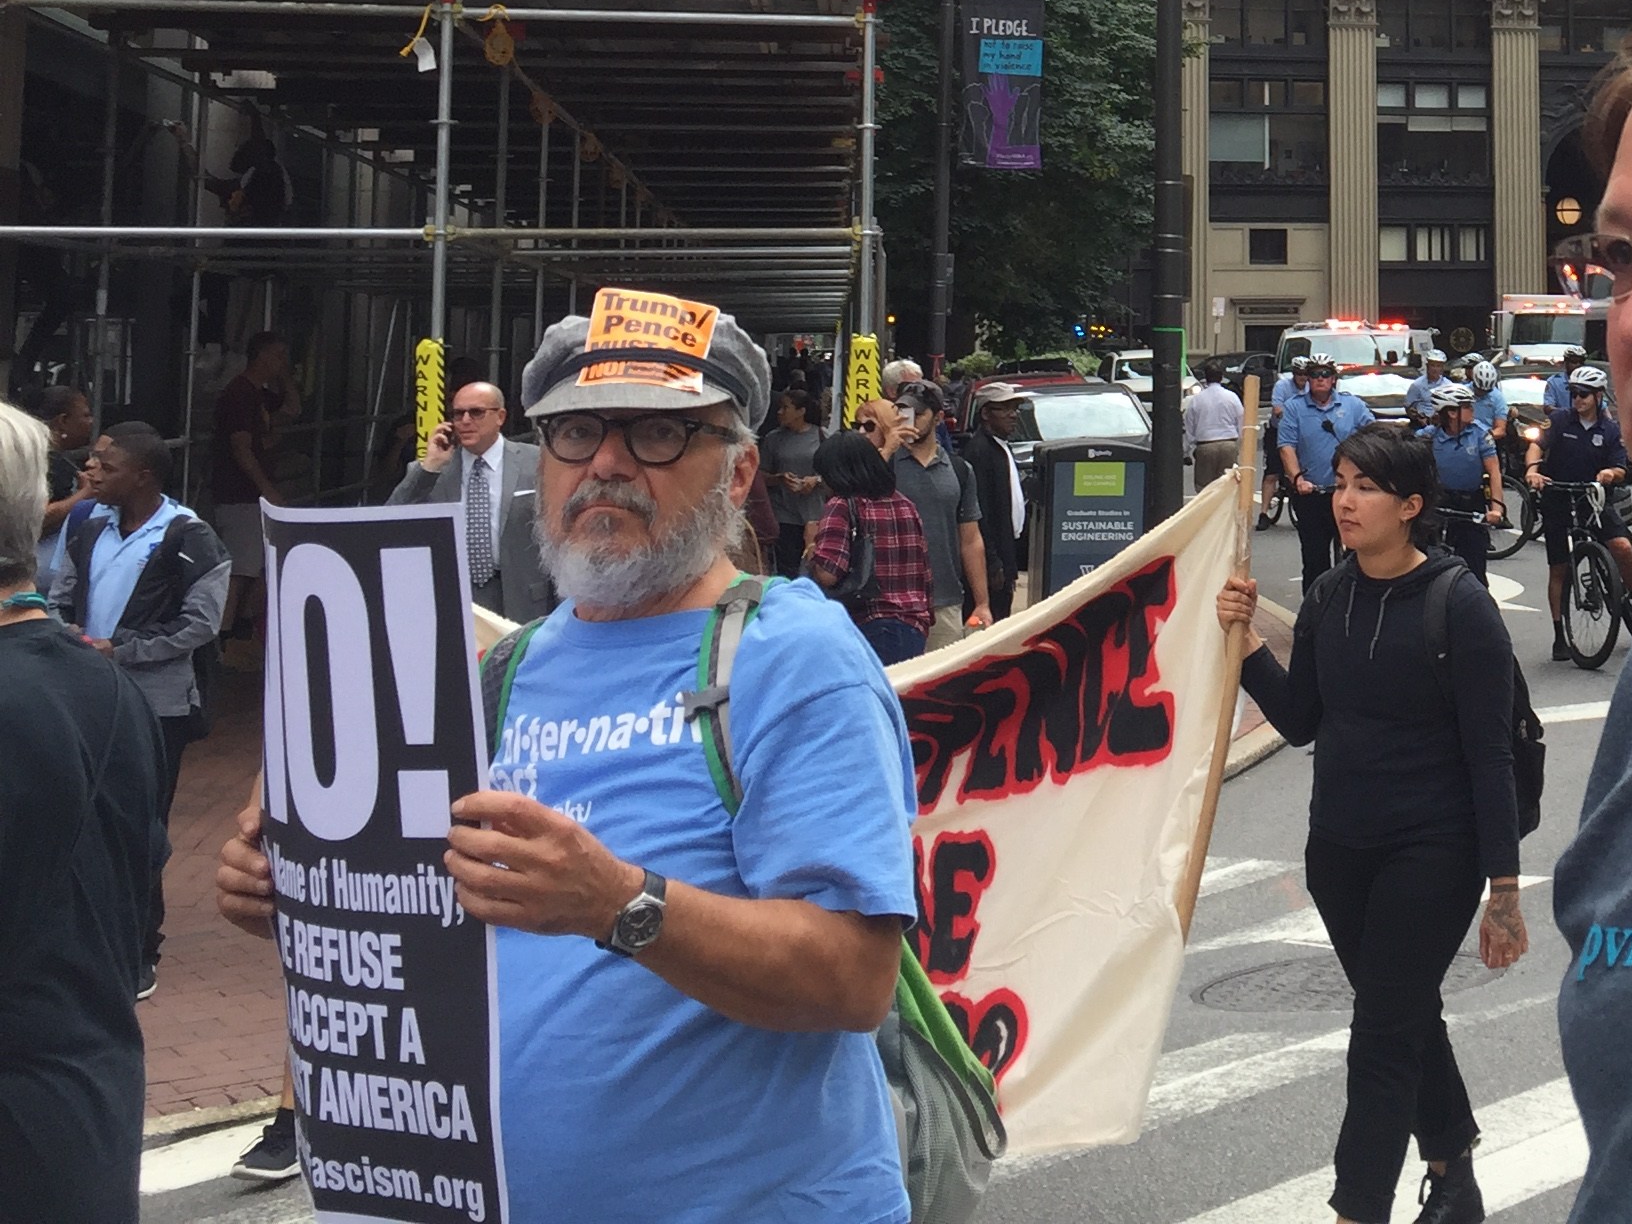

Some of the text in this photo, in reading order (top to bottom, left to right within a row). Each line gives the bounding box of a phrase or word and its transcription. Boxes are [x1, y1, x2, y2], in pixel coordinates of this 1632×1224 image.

[970, 17, 980, 34] I
[602, 292, 713, 329] Trump/
[602, 314, 698, 348] Pence
[854, 349, 872, 404] WARN
[1061, 521, 1135, 531] SUSTAINABLE
[1061, 532, 1134, 541] ENGINEERING
[310, 857, 328, 907] of
[332, 858, 464, 928] Humanity,
[293, 919, 405, 991] REFUSE
[400, 1007, 426, 1065] A
[319, 1066, 479, 1144] AMERICA
